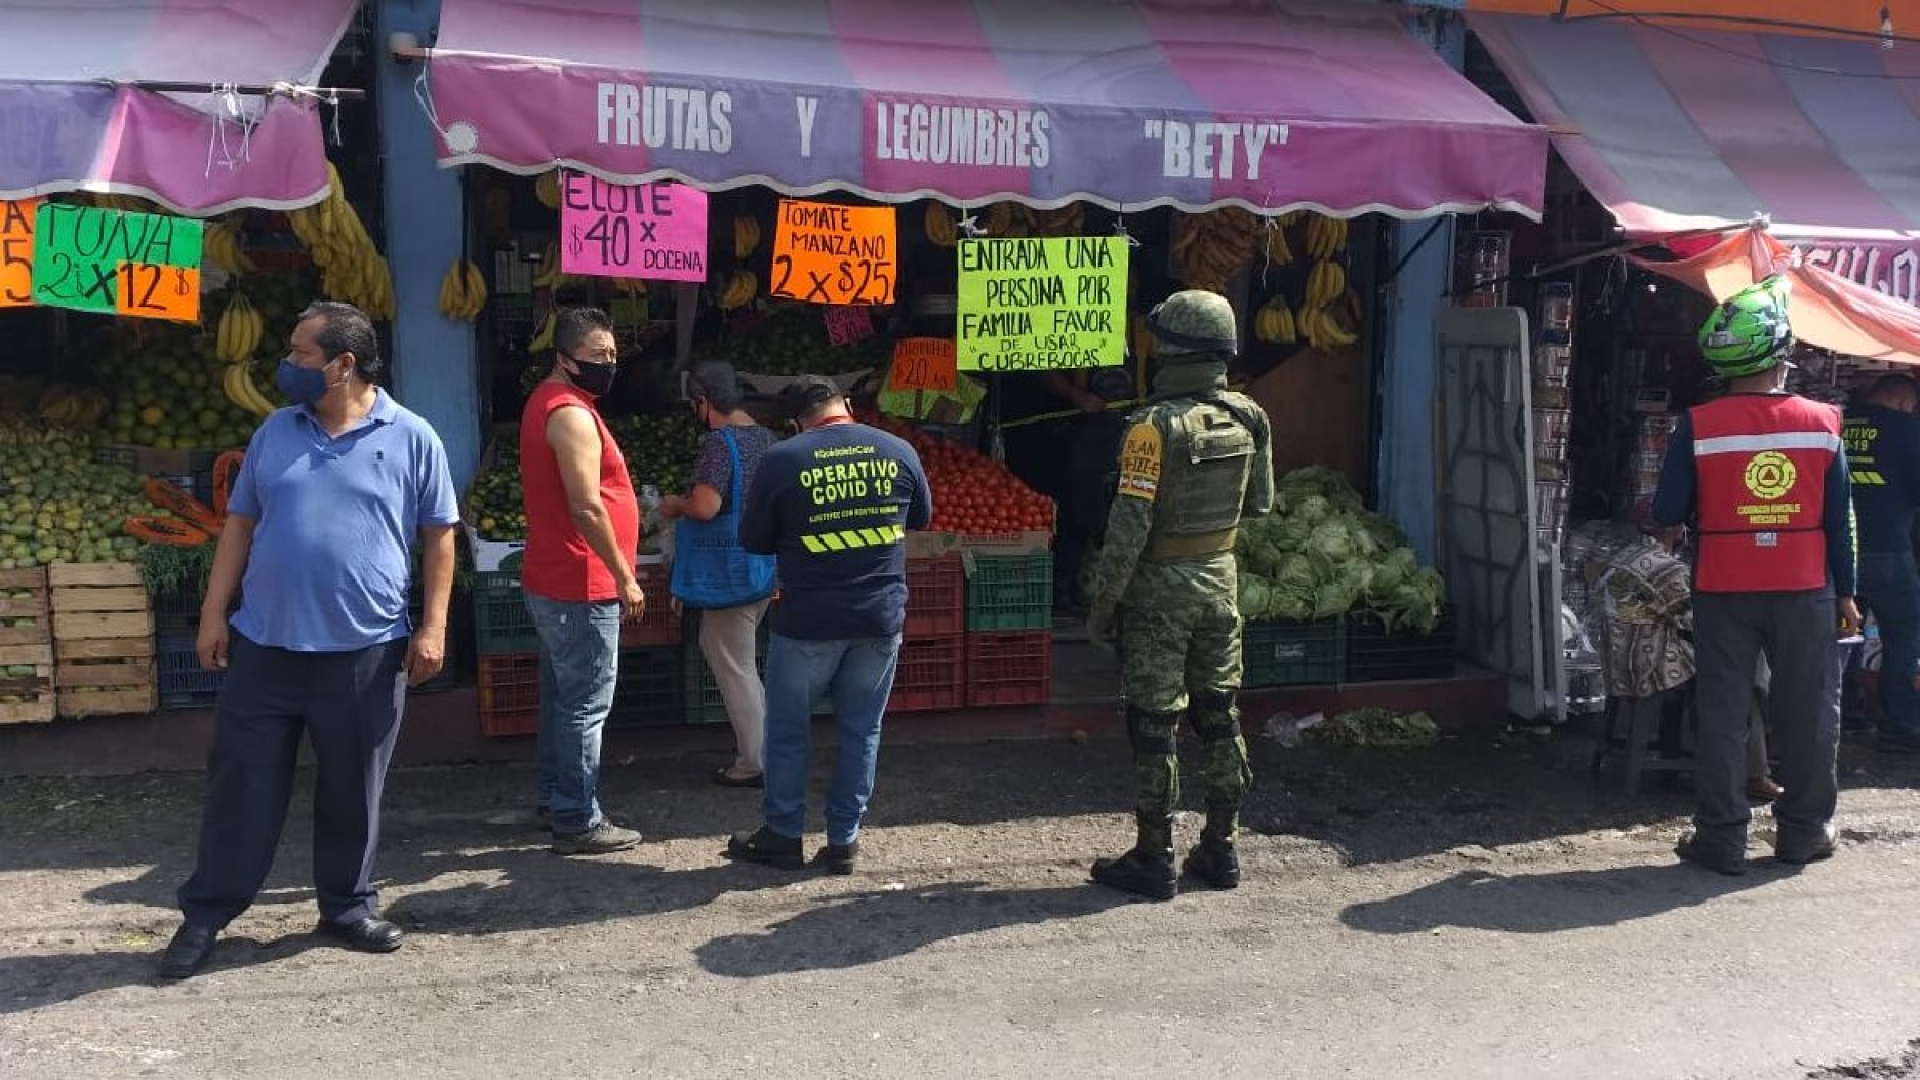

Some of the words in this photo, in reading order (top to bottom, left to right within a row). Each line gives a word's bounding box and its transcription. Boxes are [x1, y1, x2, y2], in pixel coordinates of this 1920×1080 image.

[597, 82, 732, 154] FRUTAS
[796, 96, 817, 157] Y
[876, 101, 1049, 168] LEGUMBRES
[1145, 119, 1289, 180] "BETY"
[566, 171, 673, 216] ELOTE
[783, 201, 852, 232] TOMATE
[37, 202, 174, 266] TUNA
[791, 231, 886, 260] MANZANO
[961, 239, 1049, 272] ENTRADA
[1065, 237, 1114, 269] UNA
[771, 254, 796, 298] 2
[838, 258, 891, 304] $25
[986, 275, 1067, 308] PERSONA
[1077, 275, 1112, 306] POR
[962, 312, 1033, 340] FAMILIA
[1053, 310, 1113, 334] FAVOR
[1000, 339, 1020, 353] DE
[1034, 333, 1080, 350] USAR
[800, 459, 898, 487] OPERATIVO
[812, 480, 867, 505] COVID
[874, 478, 892, 497] 19
